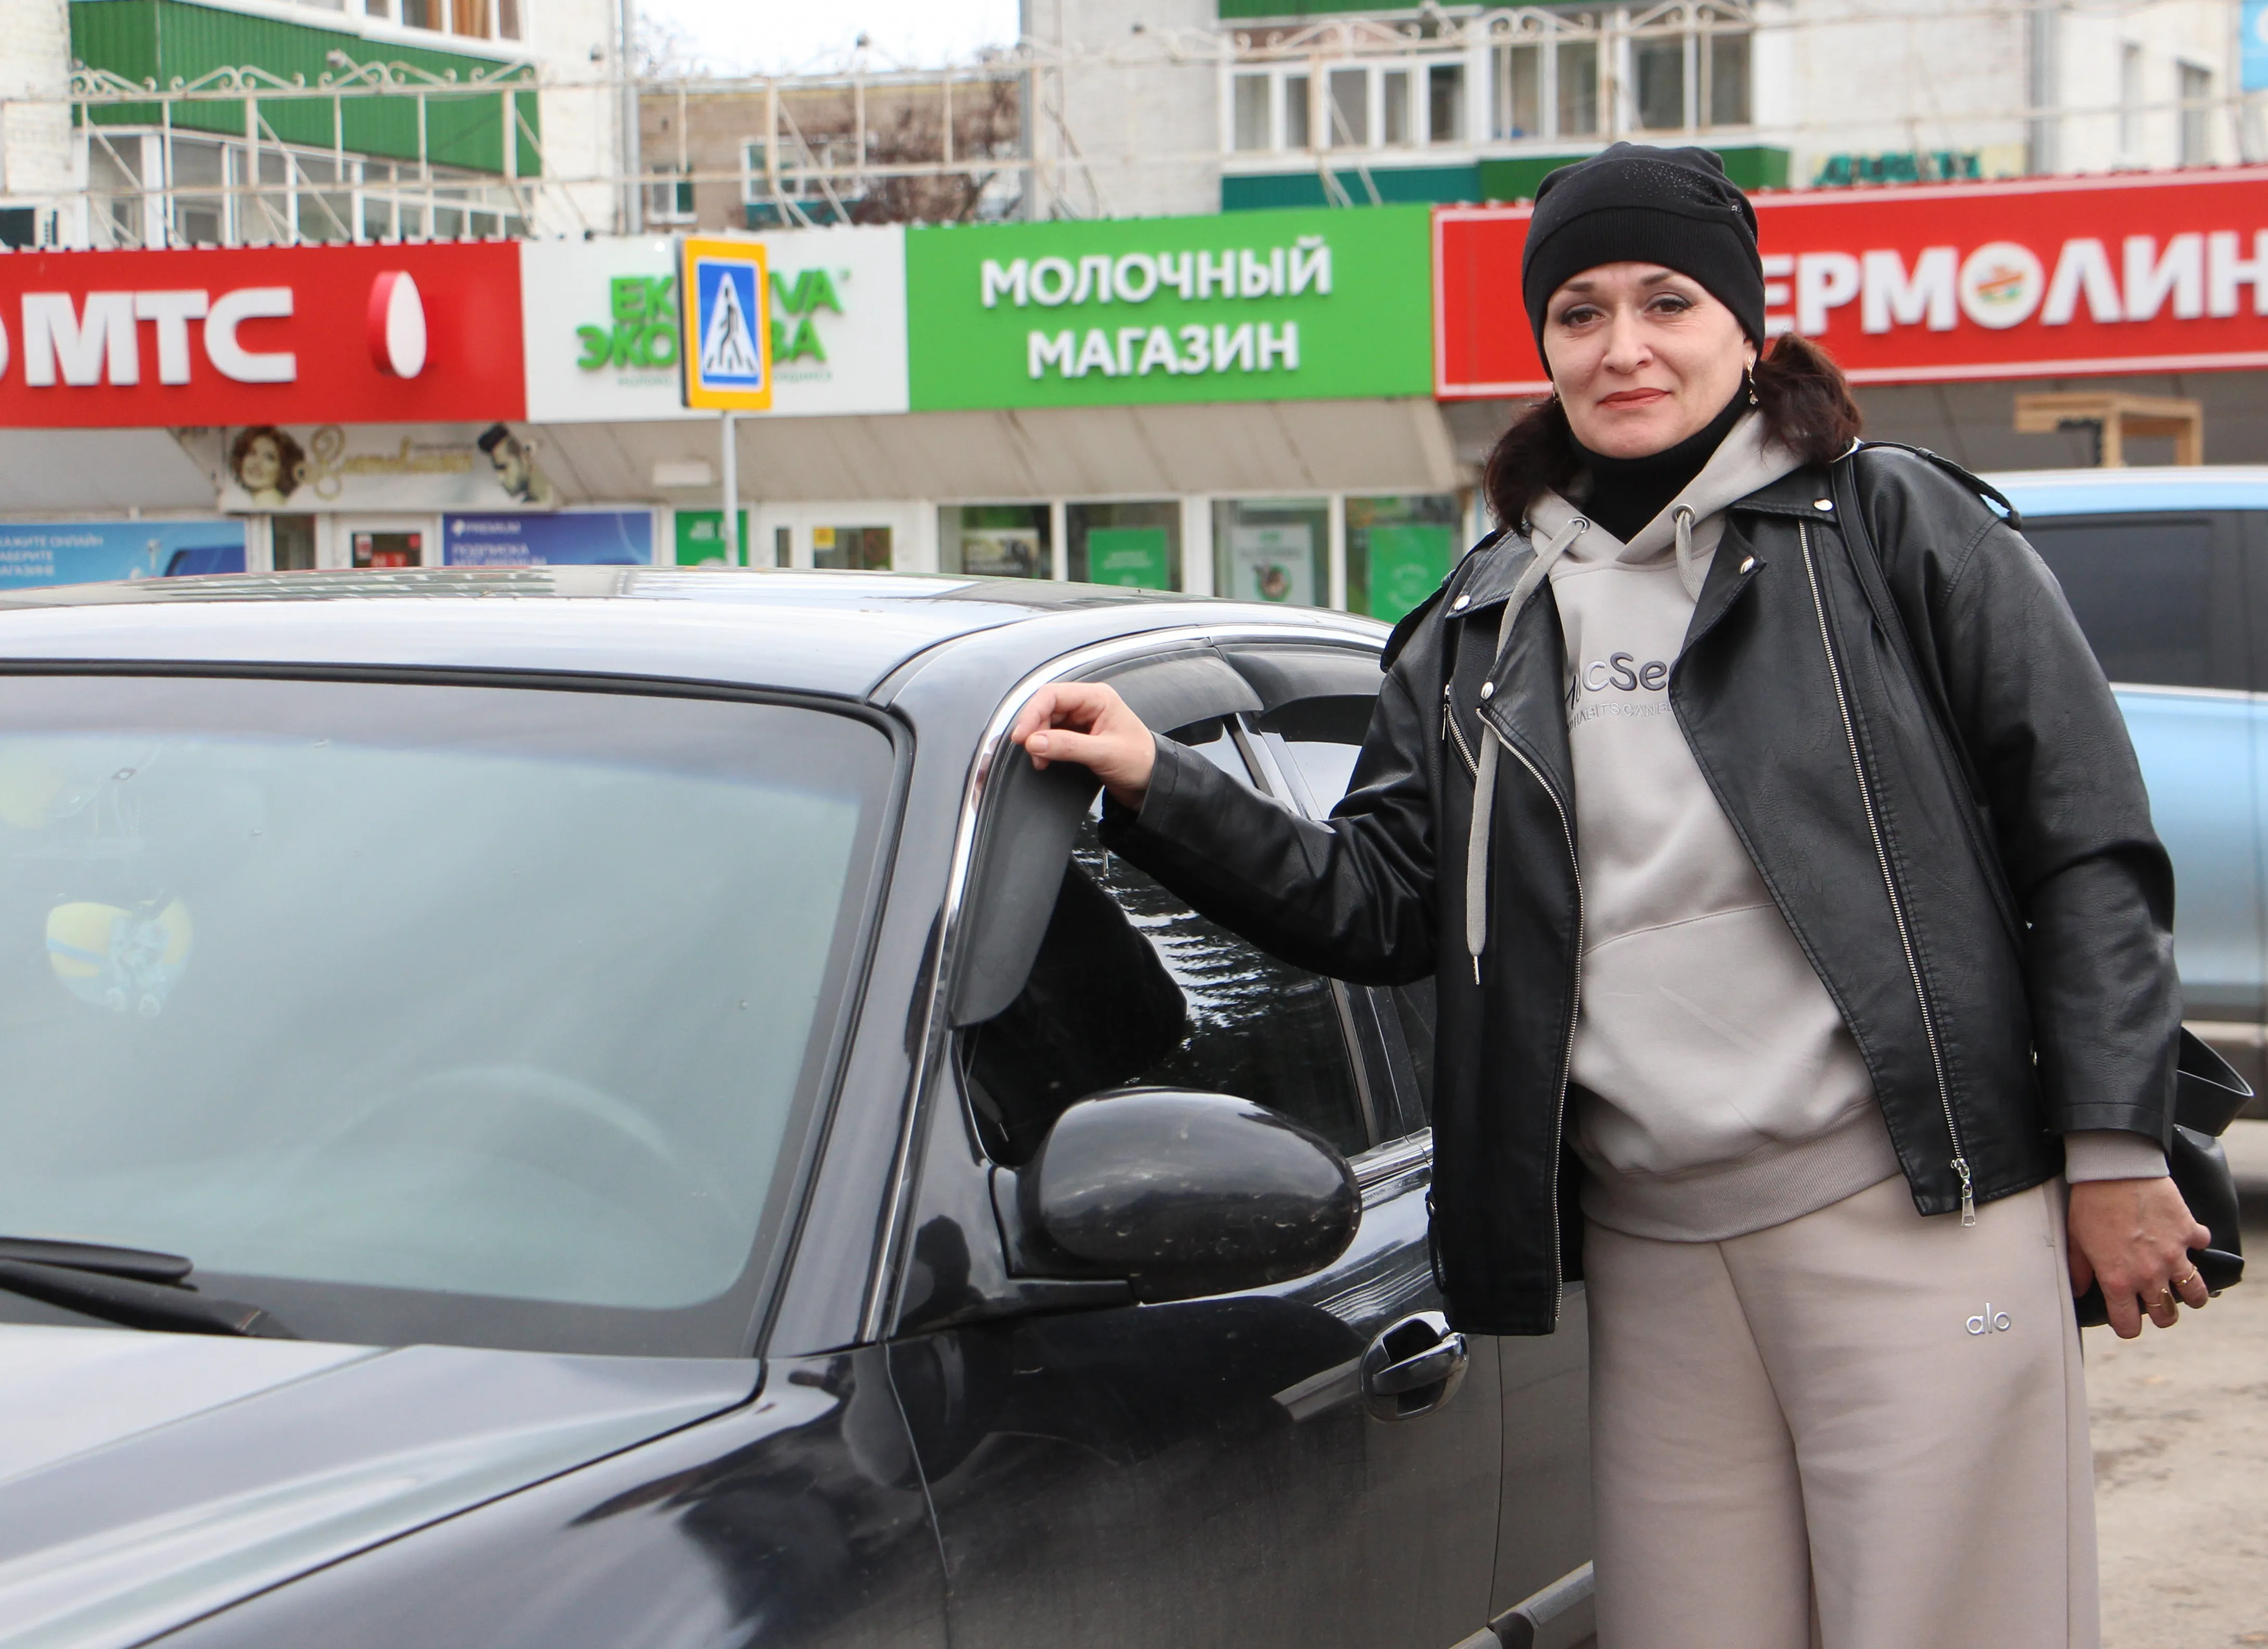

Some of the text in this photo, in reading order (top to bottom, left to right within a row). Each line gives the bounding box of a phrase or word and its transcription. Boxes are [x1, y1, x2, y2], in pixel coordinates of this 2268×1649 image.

[611, 269, 843, 319] EKVA
[981, 236, 1331, 308] МОЛОЧНЫЙ
[21, 287, 297, 386] МТС
[1028, 321, 1299, 379] МАГАЗИН
[1966, 1302, 2011, 1335] alo
